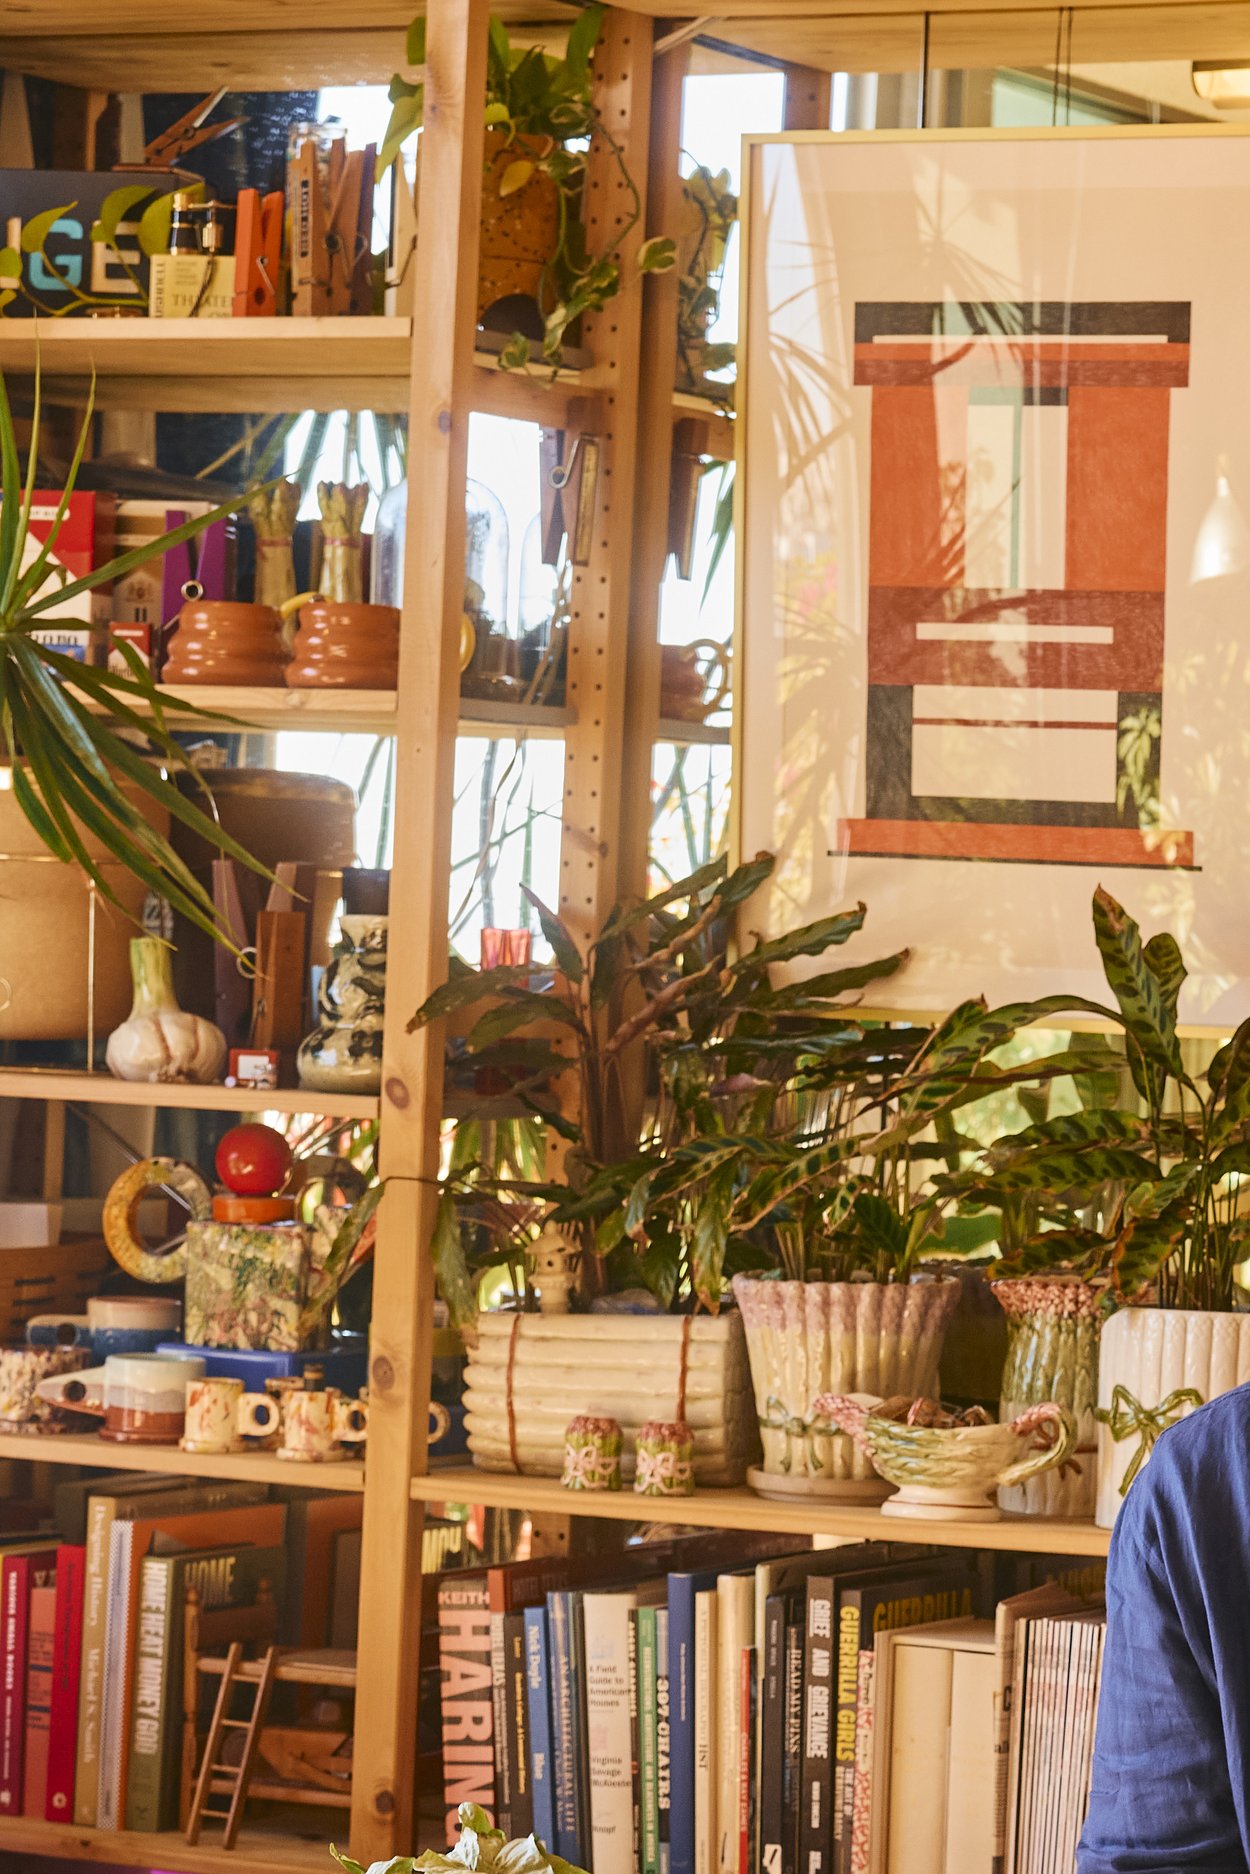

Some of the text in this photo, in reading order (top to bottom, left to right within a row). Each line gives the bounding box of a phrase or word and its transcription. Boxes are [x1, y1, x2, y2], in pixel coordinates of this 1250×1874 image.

[438, 1591, 491, 1605] KEITH
[134, 1562, 168, 1755] HOME HEAT MONEY GOD
[492, 1651, 506, 1687] TEXAS
[528, 1625, 542, 1689] Nick Doyle
[811, 1599, 831, 1759] GRIEF AND GRIEVANCE
[790, 1693, 802, 1714] MY
[836, 1606, 860, 1761] GUERRILLA GIRLS
[561, 1678, 574, 1796] ARCHITECTURAL
[656, 1678, 671, 1810] 397 CHAIRS
[789, 1718, 801, 1753] PINS
[533, 1753, 545, 1780] Blue
[565, 1803, 575, 1832] LIFE
